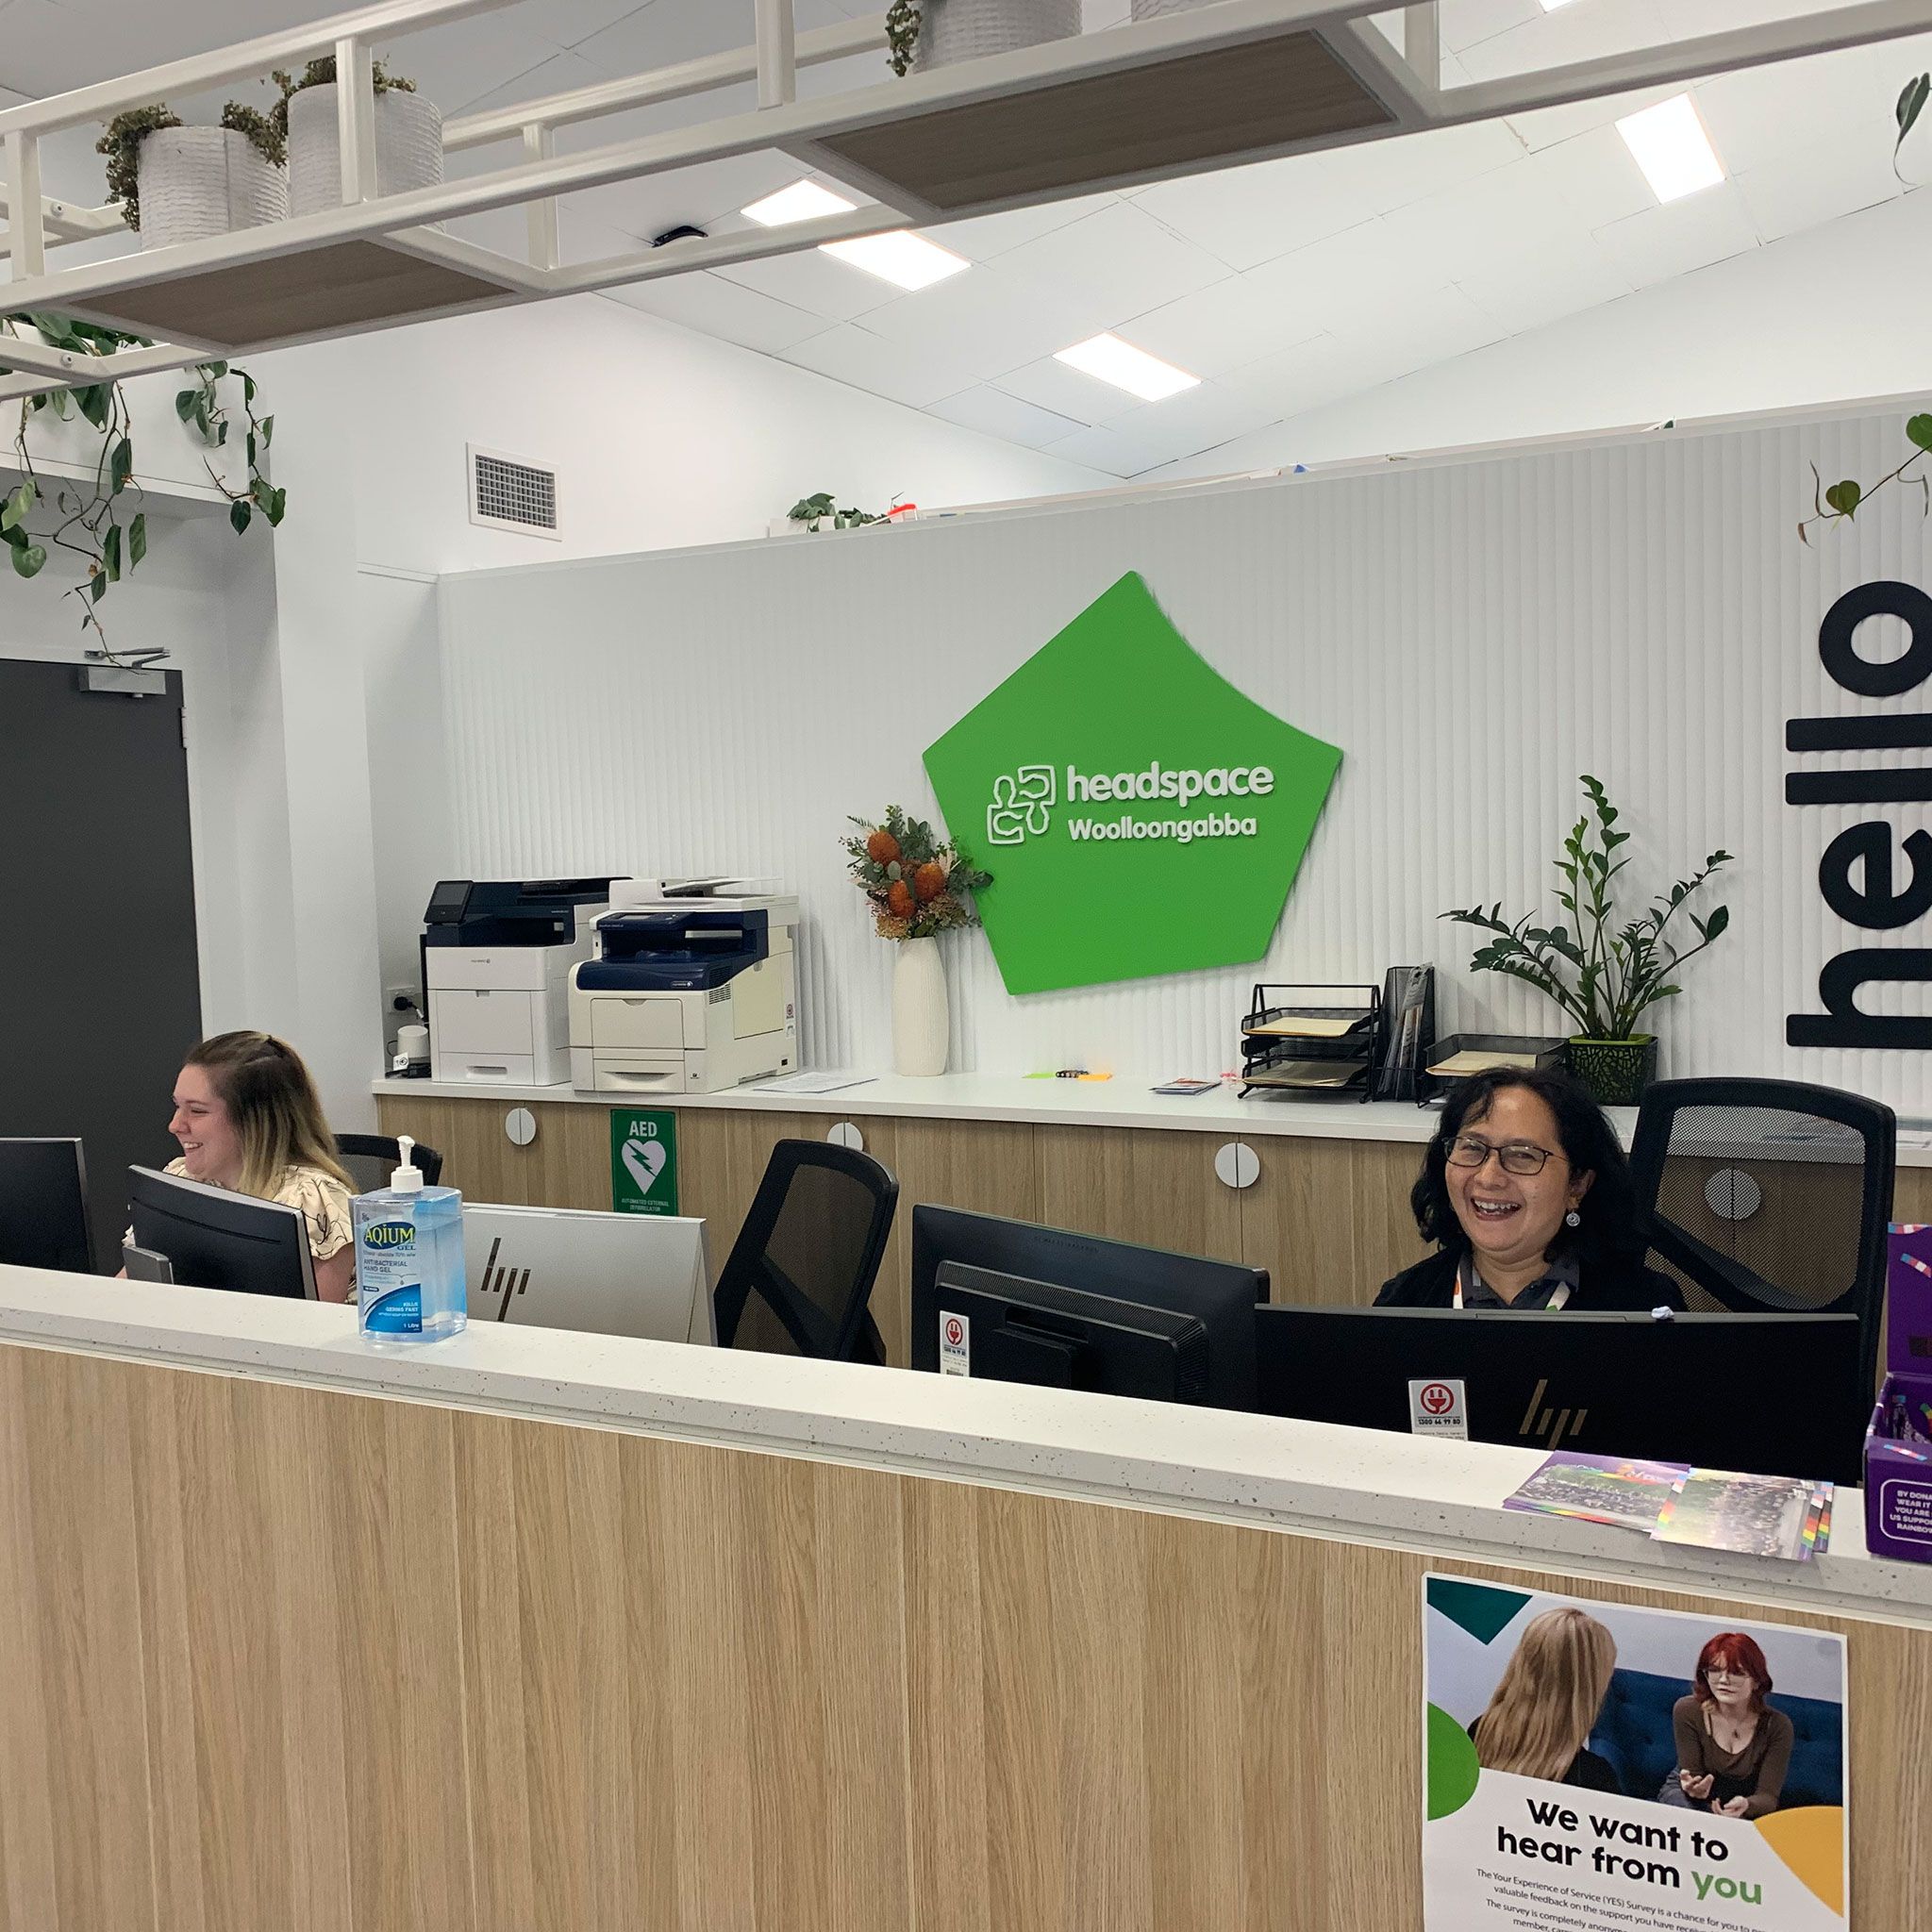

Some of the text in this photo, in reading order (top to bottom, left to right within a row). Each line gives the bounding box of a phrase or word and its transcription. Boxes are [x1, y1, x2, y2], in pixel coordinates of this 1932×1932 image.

[1067, 761, 1274, 808] headspace
[1068, 813, 1257, 843] Woolloongabba
[1786, 580, 1932, 1049] hello
[629, 1121, 658, 1137] AED
[364, 1258, 408, 1267] ANTIBACTERIAL
[1897, 1498, 1922, 1507] WEAR
[1526, 1799, 1729, 1861] We want to
[1497, 1826, 1762, 1905] hear from you
[1476, 1869, 1492, 1879] The
[1492, 1873, 1511, 1883] Your
[1513, 1876, 1557, 1892] Experience
[1571, 1889, 1601, 1903] Service
[1603, 1896, 1624, 1908] (YES)
[1626, 1901, 1656, 1915] Survey
[1674, 1911, 1705, 1924] chance
[1707, 1917, 1720, 1926] for
[1721, 1922, 1739, 1931] you
[1487, 1898, 1502, 1909] The
[1503, 1904, 1530, 1917] survey
[1531, 1909, 1539, 1918] is
[1540, 1912, 1587, 1929] completely
[1494, 1887, 1528, 1900] valuable
[1530, 1893, 1568, 1907] feedback
[1570, 1902, 1581, 1910] on
[1583, 1905, 1601, 1914] the
[1599, 1909, 1633, 1923] support
[1635, 1916, 1652, 1926] you
[1653, 1919, 1674, 1931] have
